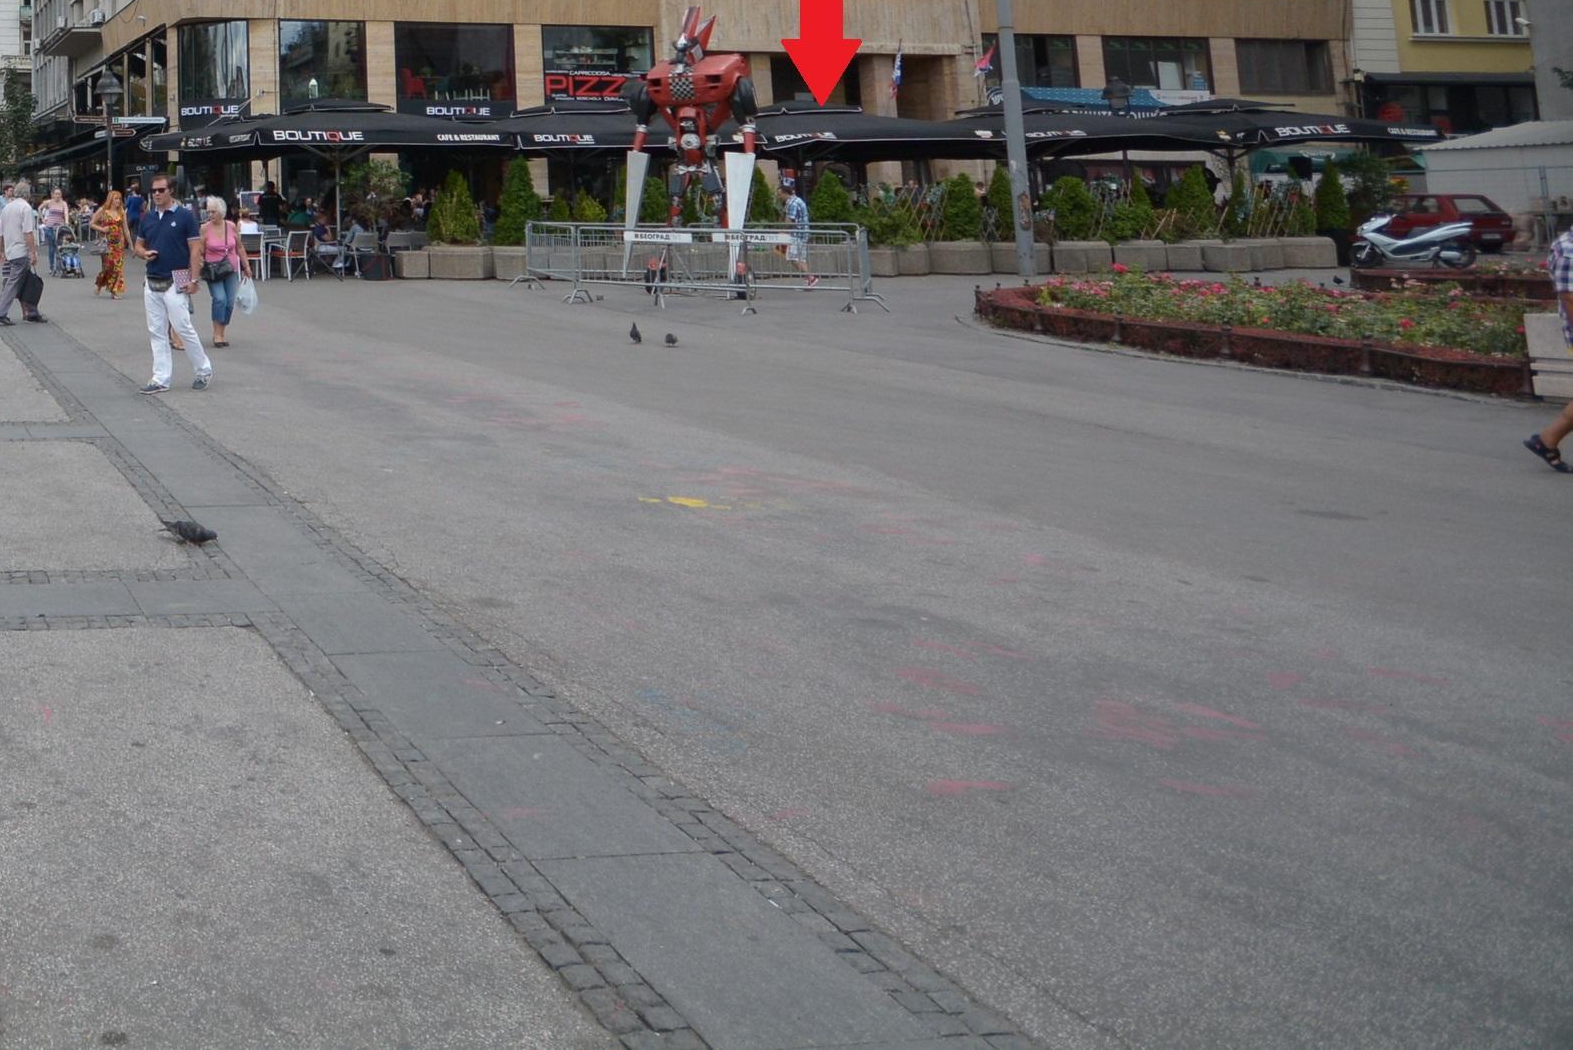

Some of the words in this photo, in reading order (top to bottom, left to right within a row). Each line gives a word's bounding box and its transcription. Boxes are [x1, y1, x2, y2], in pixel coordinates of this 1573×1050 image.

[545, 75, 626, 97] PIZZ
[181, 105, 239, 116] BOUTIQUE
[426, 106, 490, 116] BOUTIQUE
[1275, 123, 1351, 137] BOUTIQUE
[273, 130, 364, 142] BOUTIQUE
[437, 133, 453, 142] CAFE
[453, 133, 460, 142] &
[460, 133, 500, 142] RESTAURANT
[533, 134, 594, 143] BOUTIQUE
[774, 132, 837, 143] BOUTIQUE
